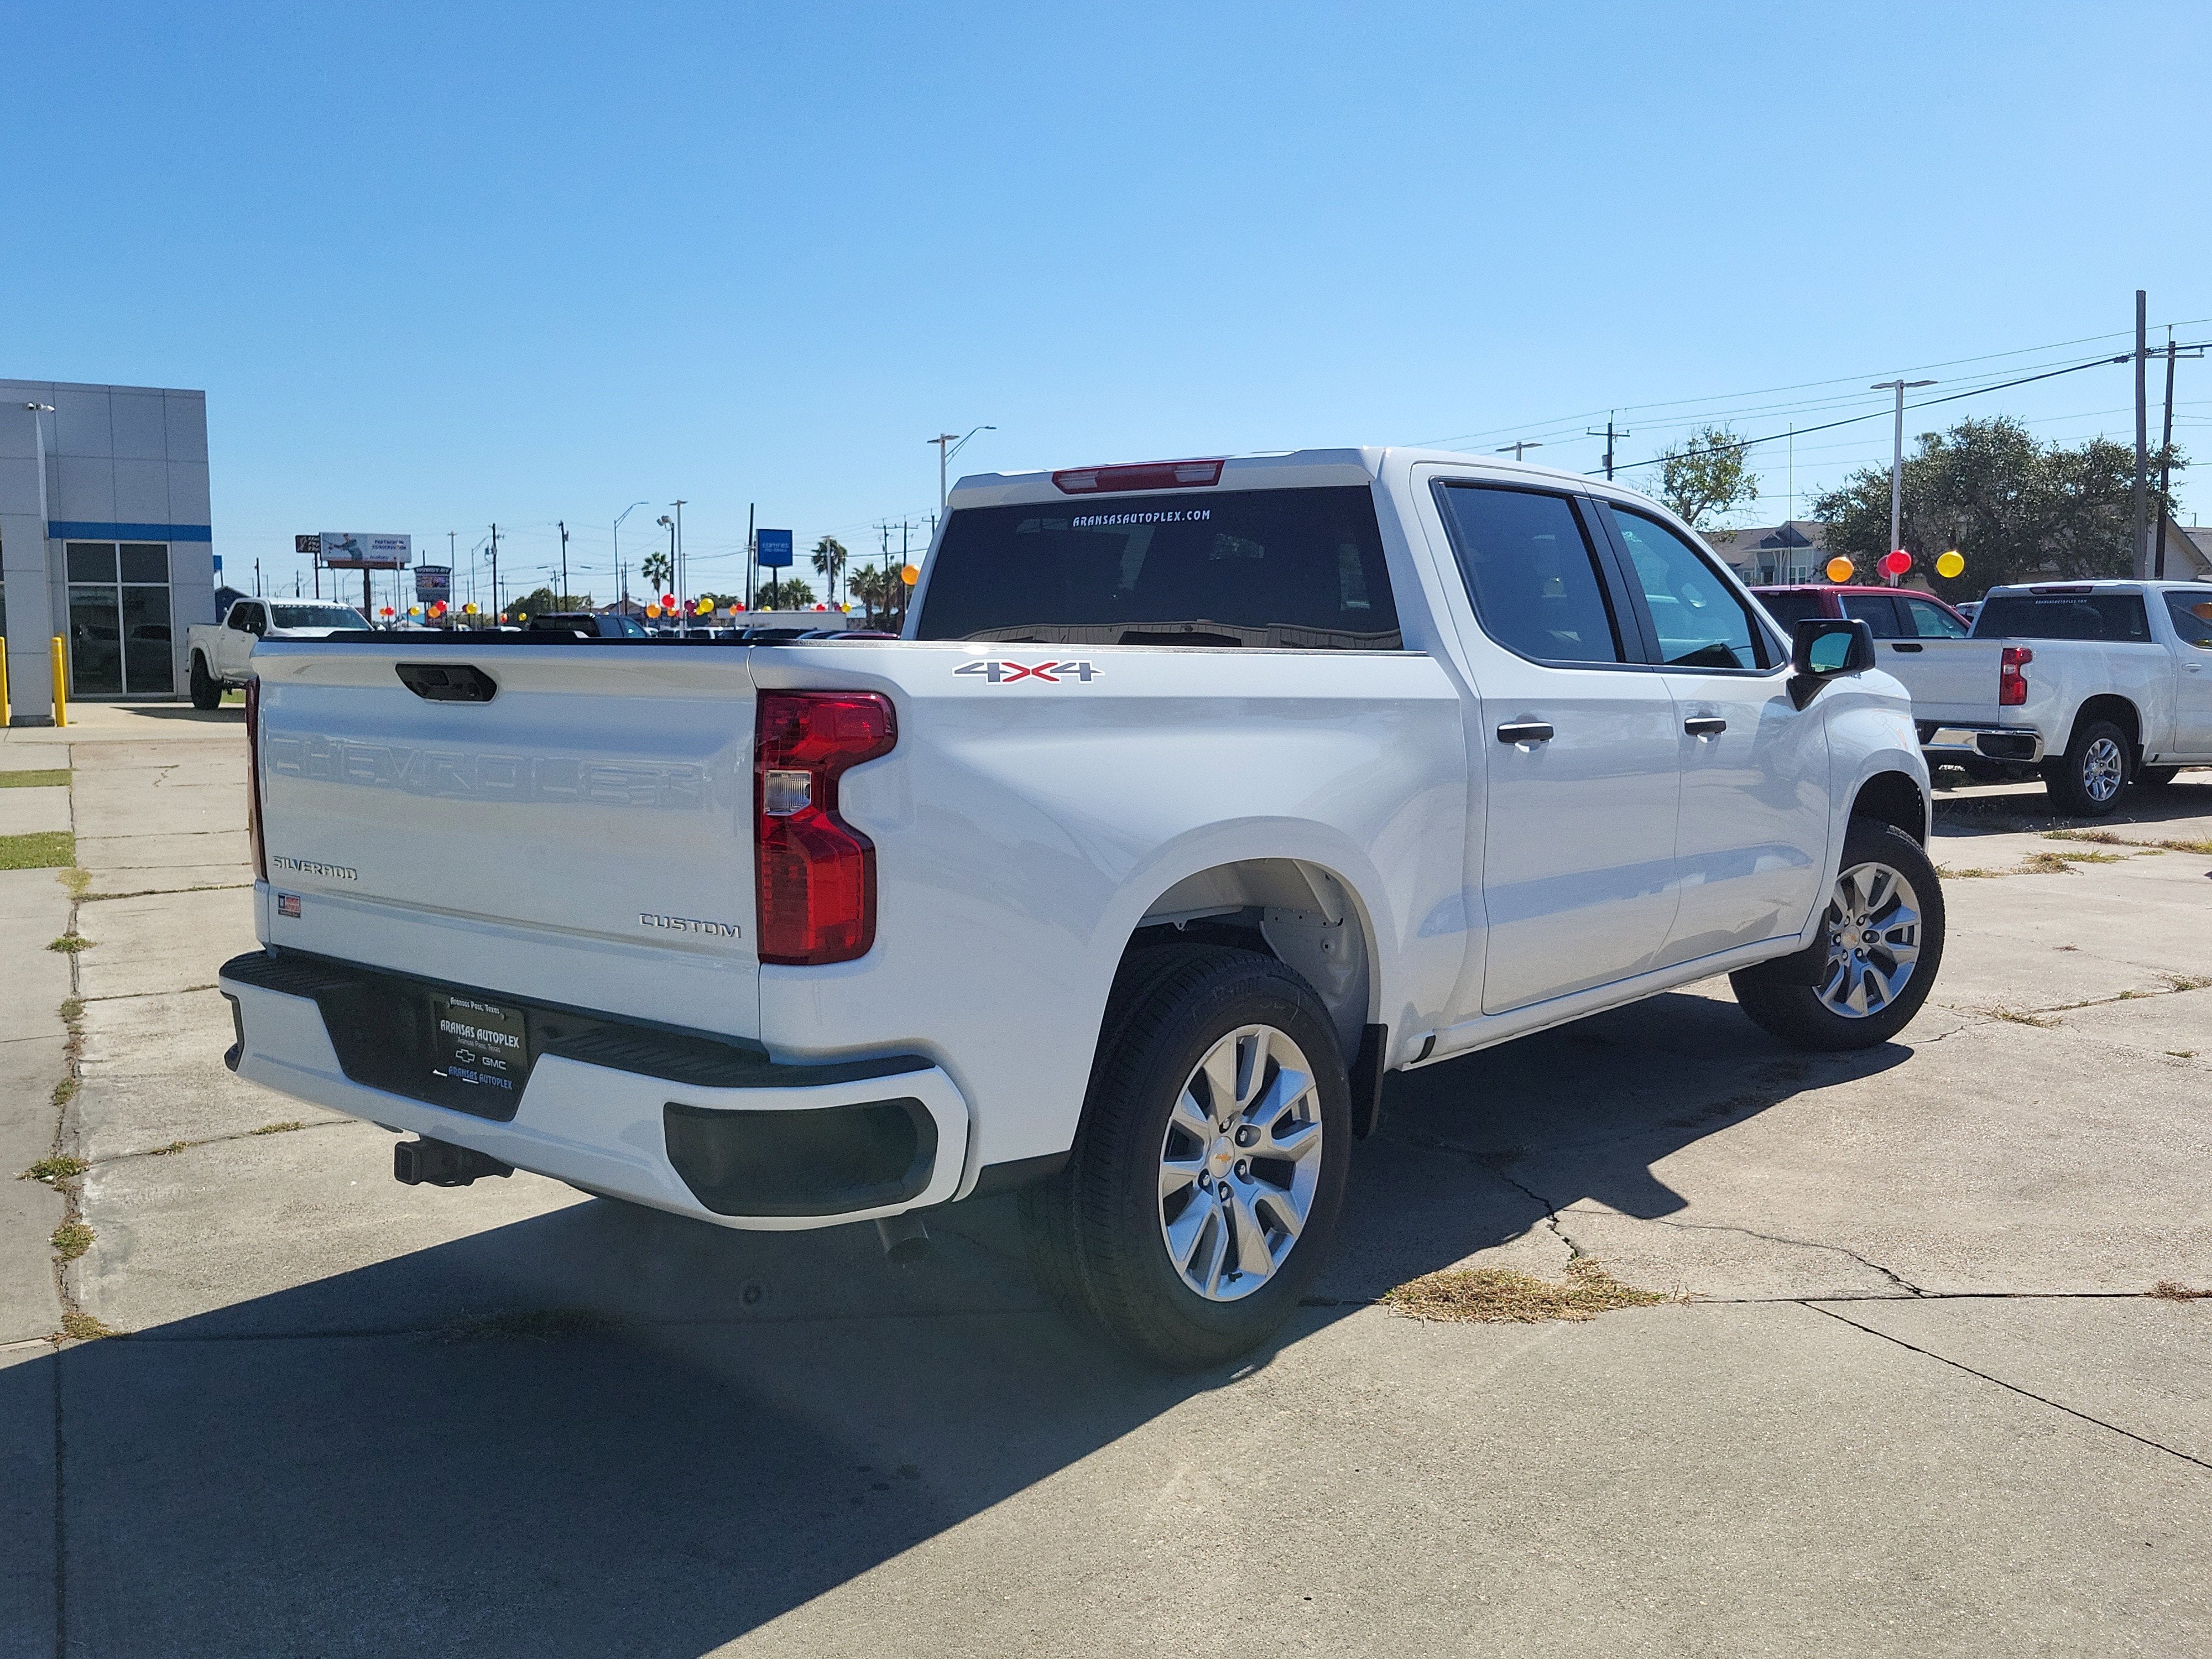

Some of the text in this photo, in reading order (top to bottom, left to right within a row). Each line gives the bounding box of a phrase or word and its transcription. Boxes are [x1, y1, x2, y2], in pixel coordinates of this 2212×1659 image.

[1073, 510, 1211, 527] ARANSASAUTOPLEX.COM
[273, 855, 357, 880] SILVERADO
[639, 913, 741, 938] CUSTOM
[485, 1004, 500, 1014] Texas
[440, 1019, 519, 1048] ARANSAS AUTOPLEX
[482, 1057, 507, 1070] GMC
[448, 1066, 513, 1090] ARANSAS AUTOPLEX
